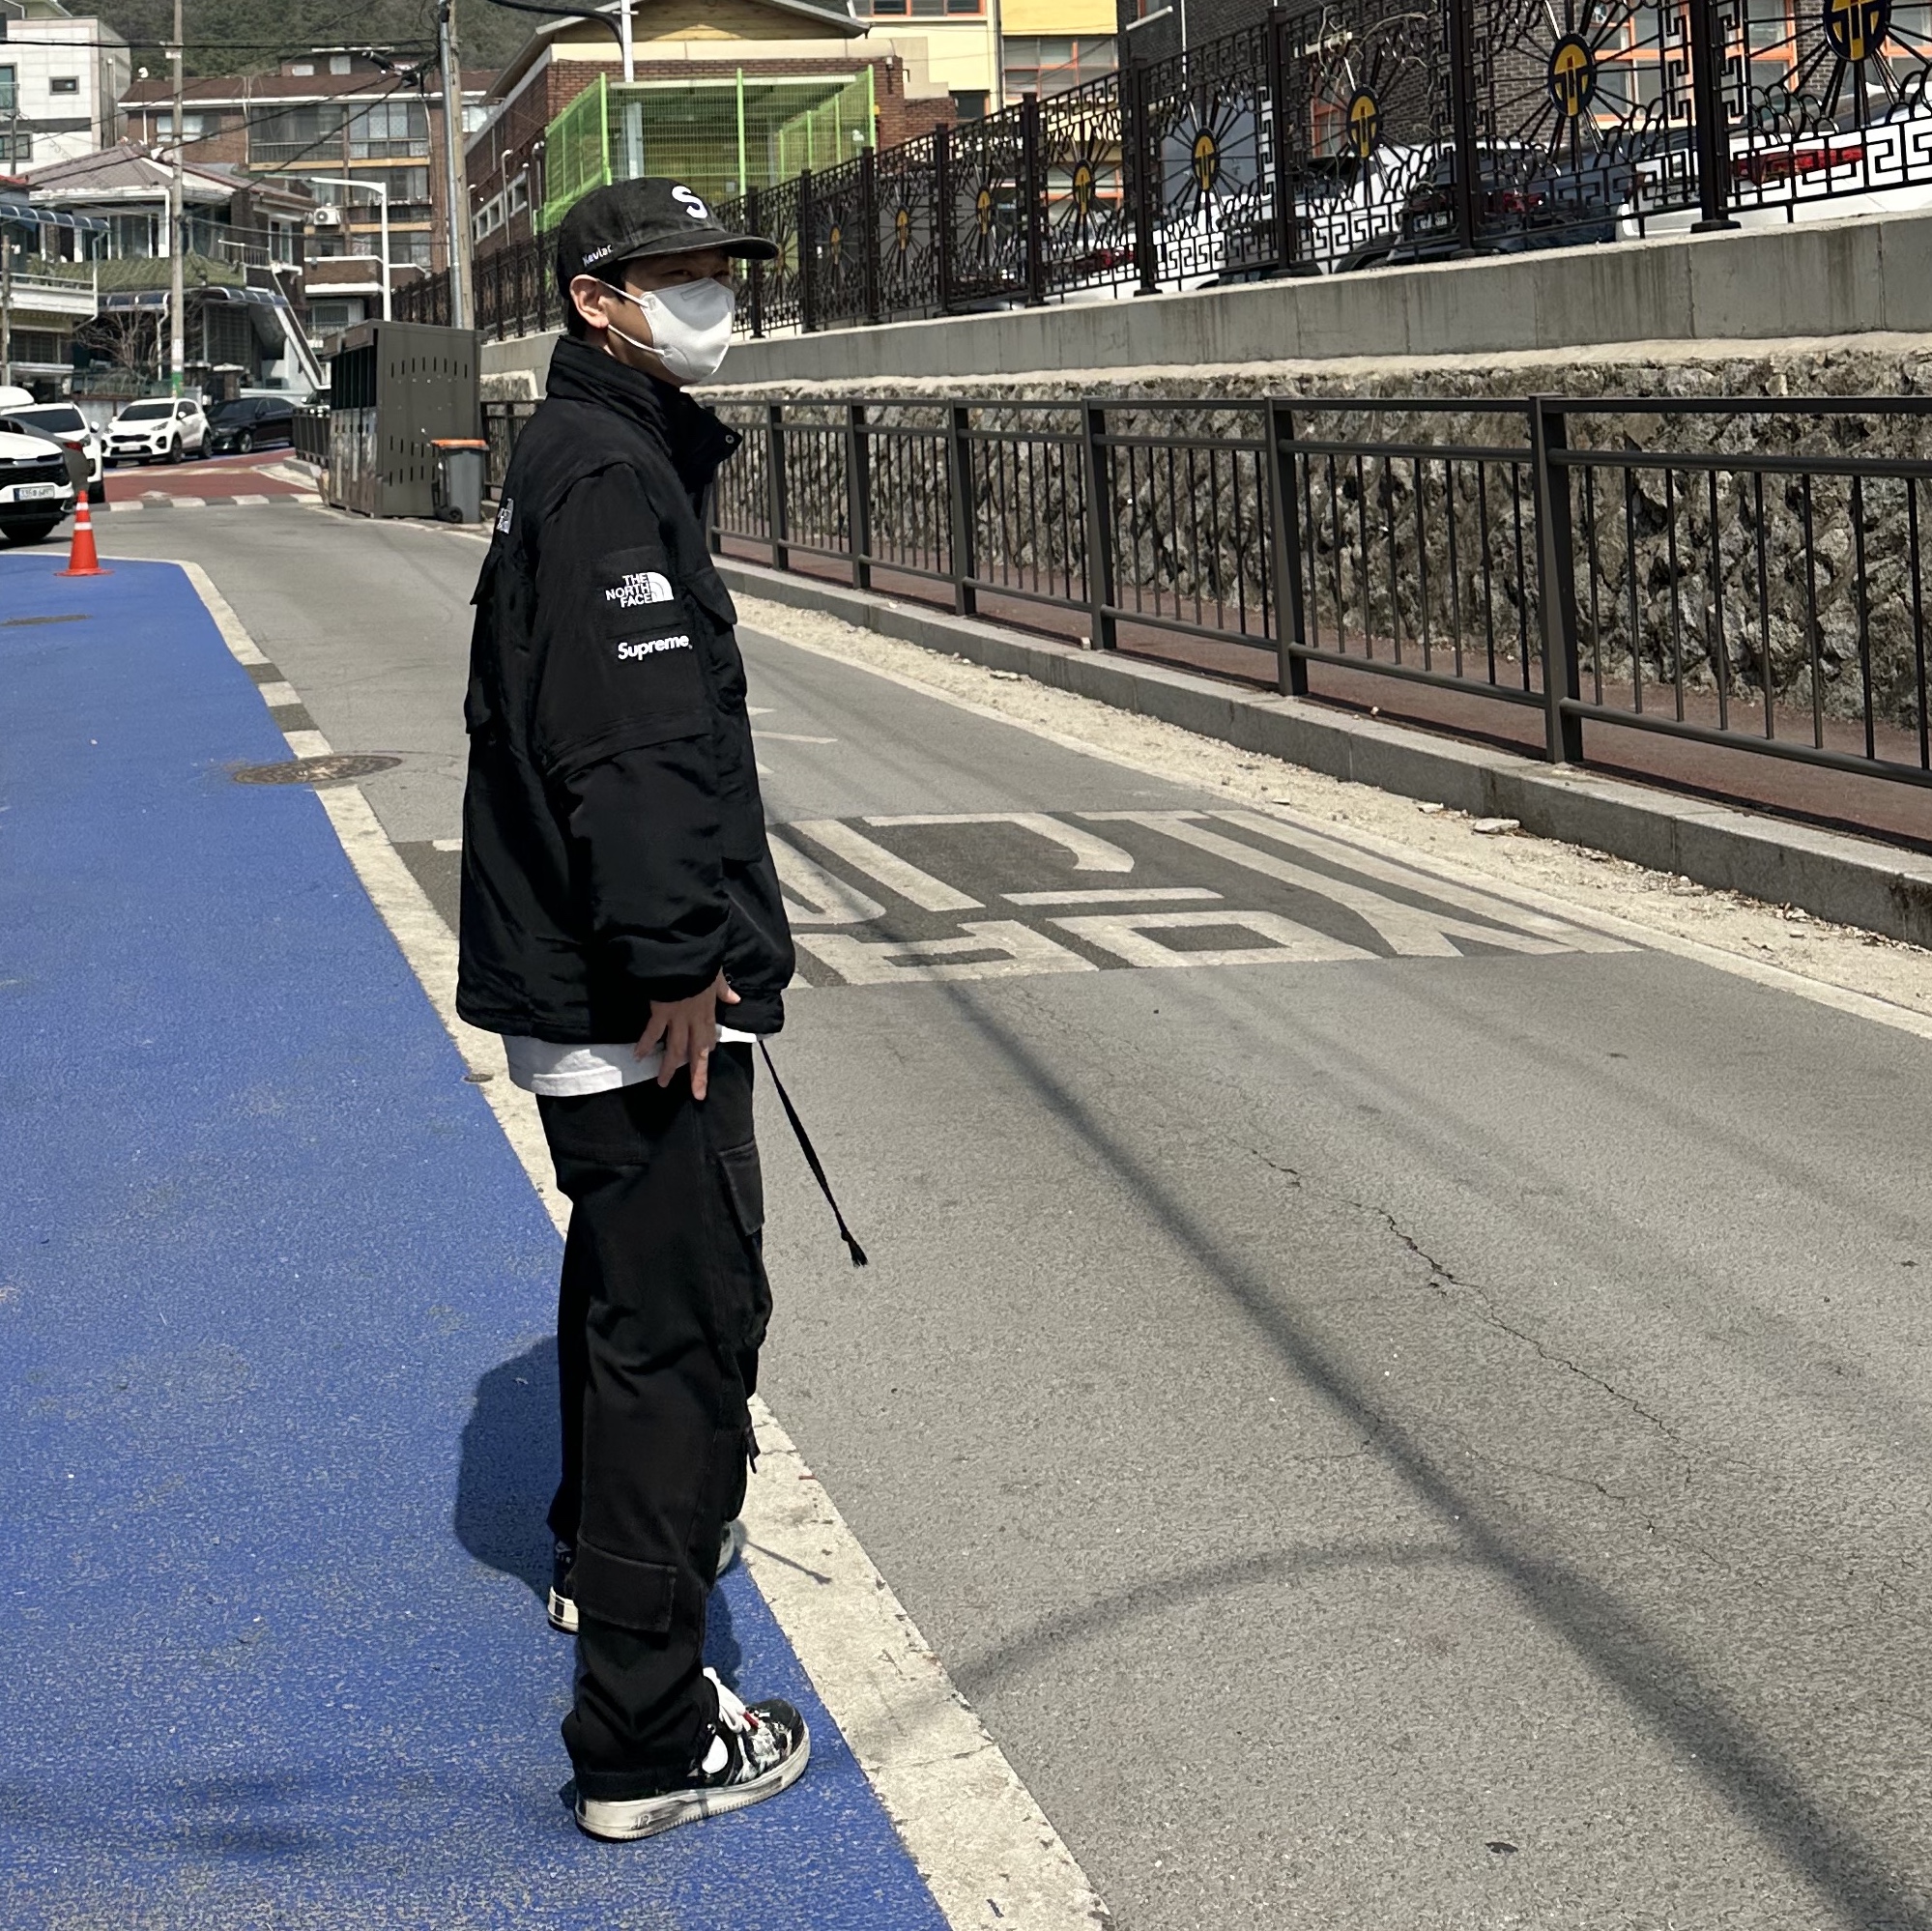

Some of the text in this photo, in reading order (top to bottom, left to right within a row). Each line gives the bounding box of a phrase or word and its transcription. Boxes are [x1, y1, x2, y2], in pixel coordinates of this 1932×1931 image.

[672, 186, 708, 219] S
[582, 244, 614, 268] Kevlar
[621, 572, 649, 587] THE
[605, 582, 650, 601] NORTH
[620, 592, 652, 608] FACE
[618, 635, 690, 661] Supreme
